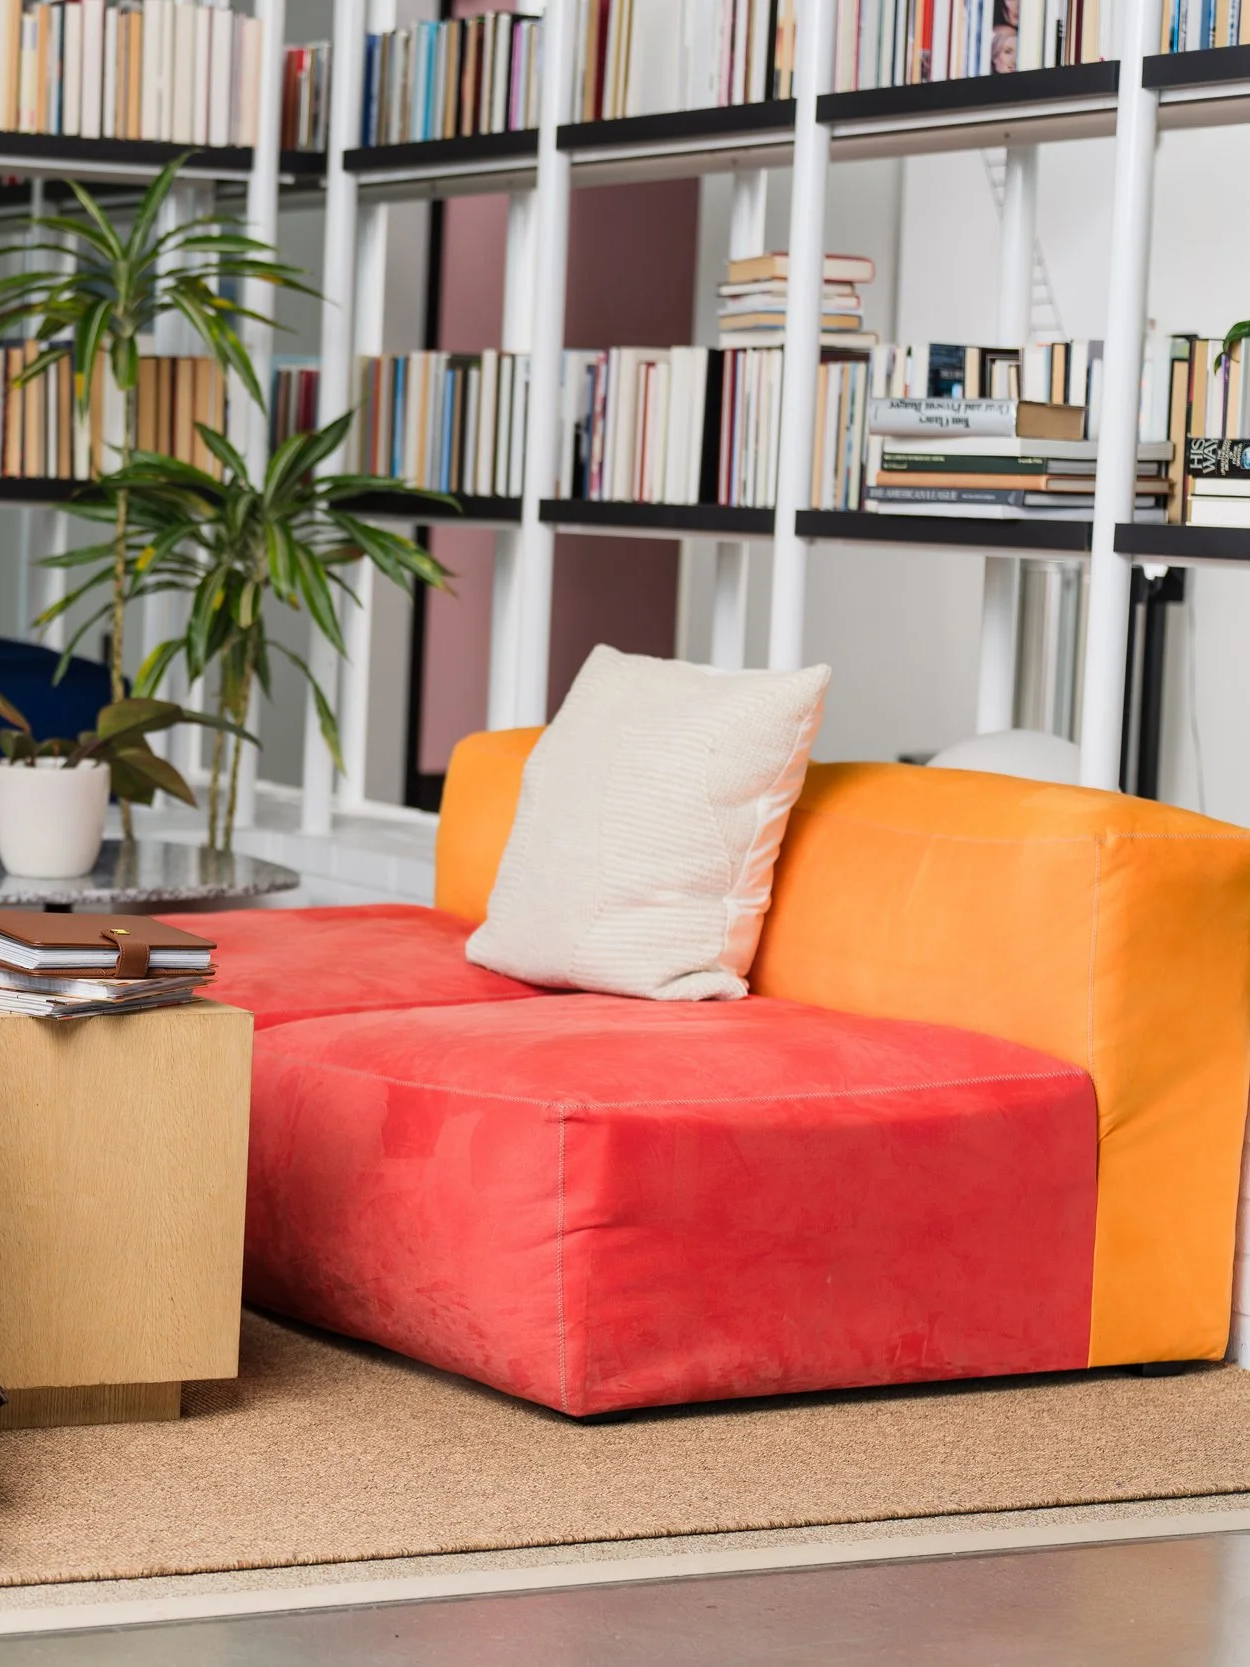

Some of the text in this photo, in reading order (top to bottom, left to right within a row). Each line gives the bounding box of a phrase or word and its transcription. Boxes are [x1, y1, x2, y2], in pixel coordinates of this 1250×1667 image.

[888, 400, 922, 413] Danger
[919, 416, 950, 428] Clancy
[1190, 439, 1205, 469] HIS
[1202, 439, 1219, 474] WAY
